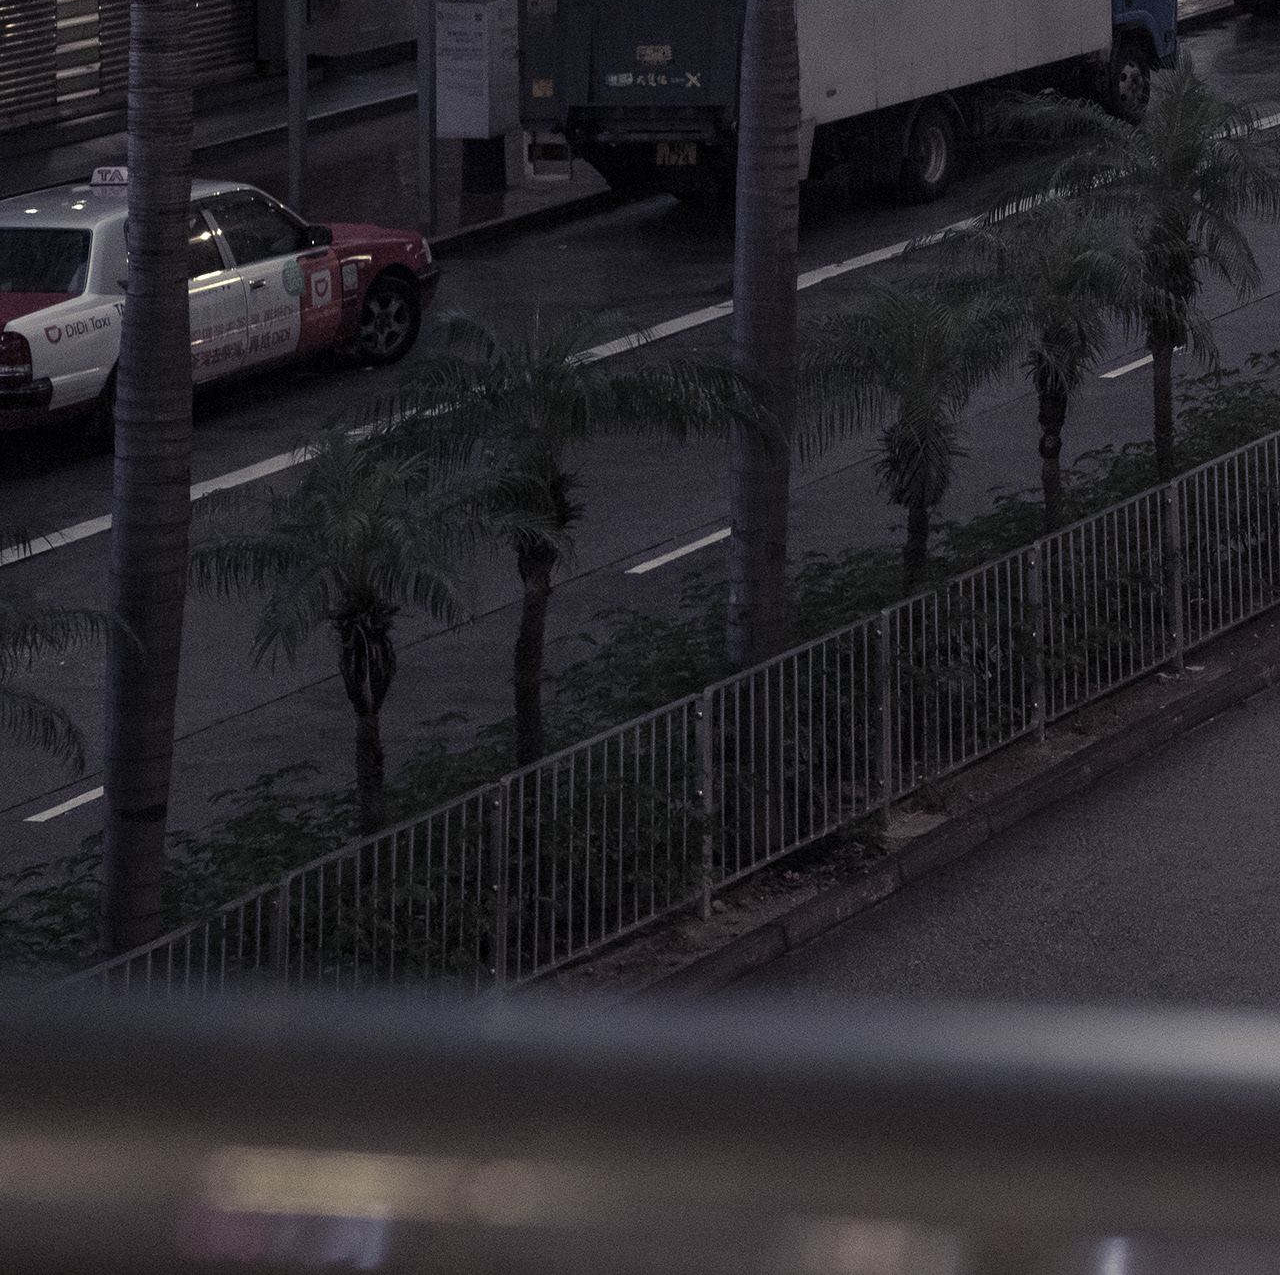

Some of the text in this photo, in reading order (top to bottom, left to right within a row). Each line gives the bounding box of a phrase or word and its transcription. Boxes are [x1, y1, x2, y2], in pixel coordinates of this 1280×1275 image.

[96, 168, 127, 183] TA
[65, 316, 111, 339] DiDi Taxi
